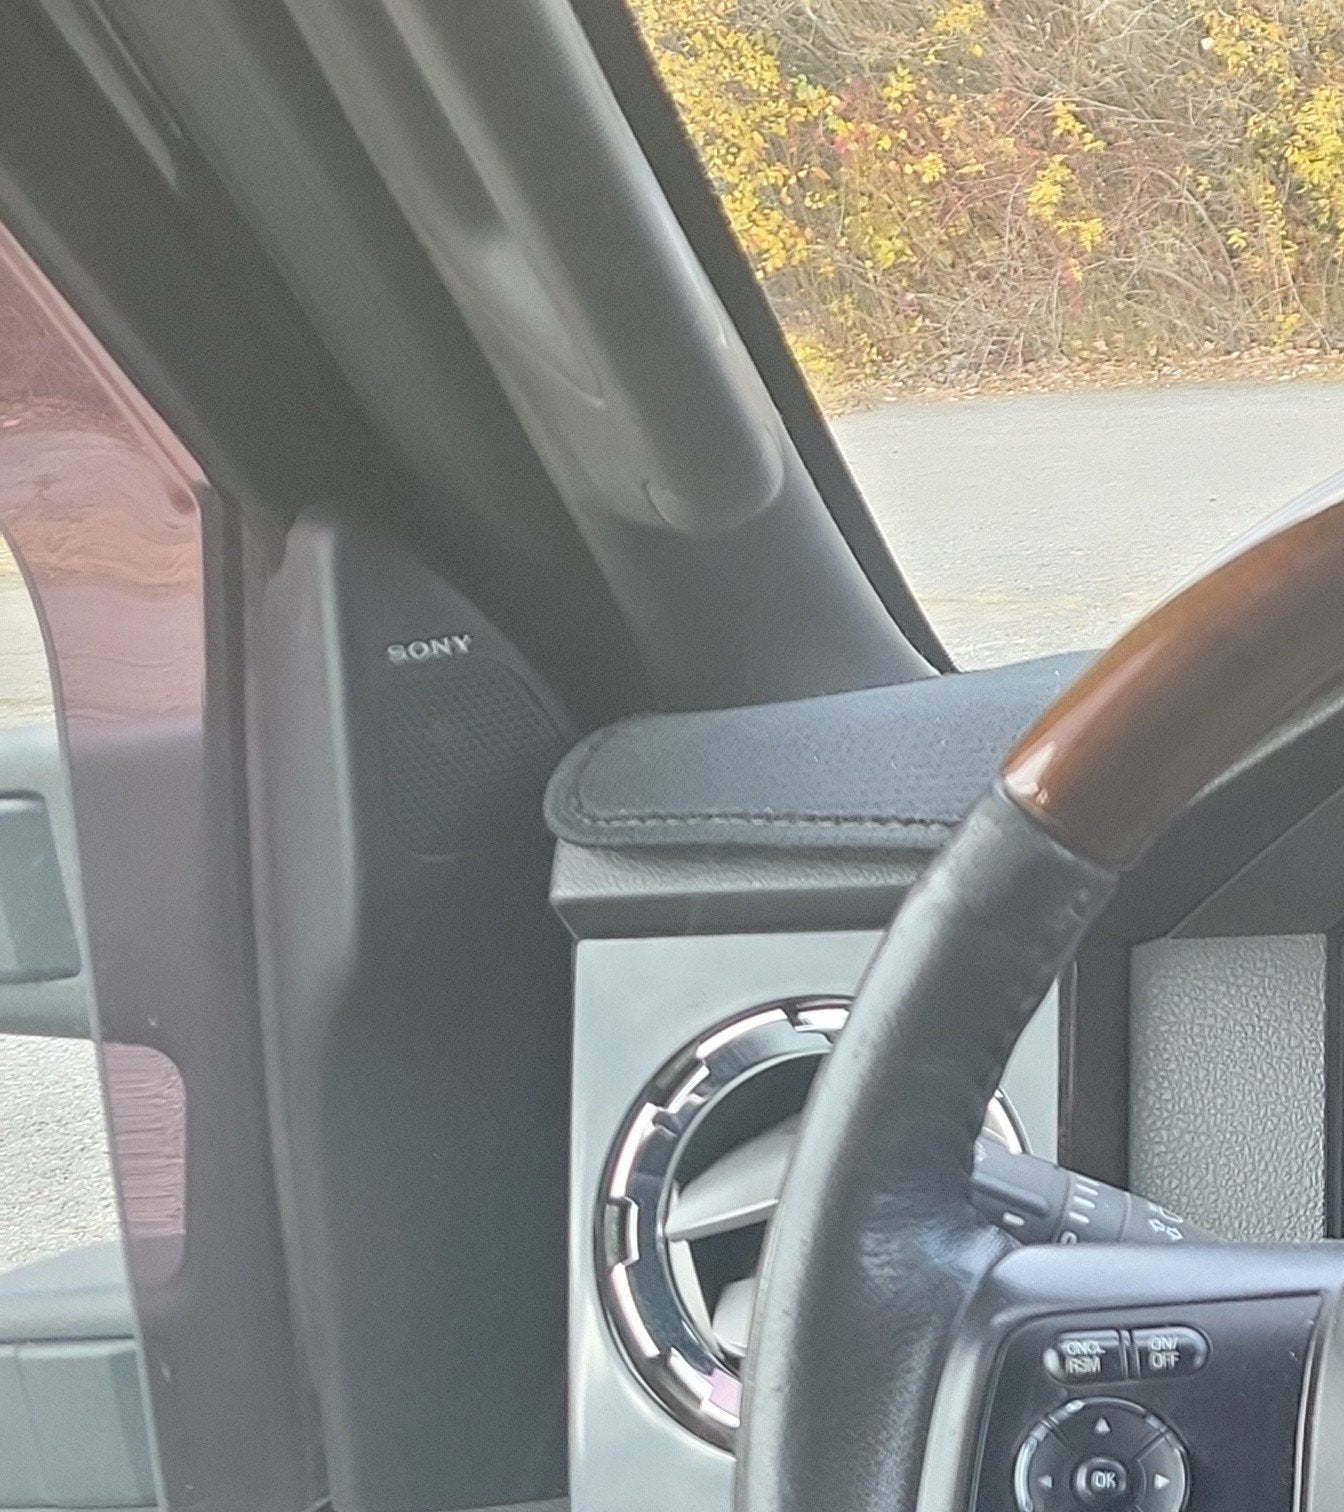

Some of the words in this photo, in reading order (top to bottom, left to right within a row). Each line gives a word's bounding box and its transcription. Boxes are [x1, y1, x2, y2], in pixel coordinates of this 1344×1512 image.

[387, 634, 471, 664] SONY
[1149, 1351, 1180, 1369] OFF
[1093, 1471, 1116, 1488] OK
